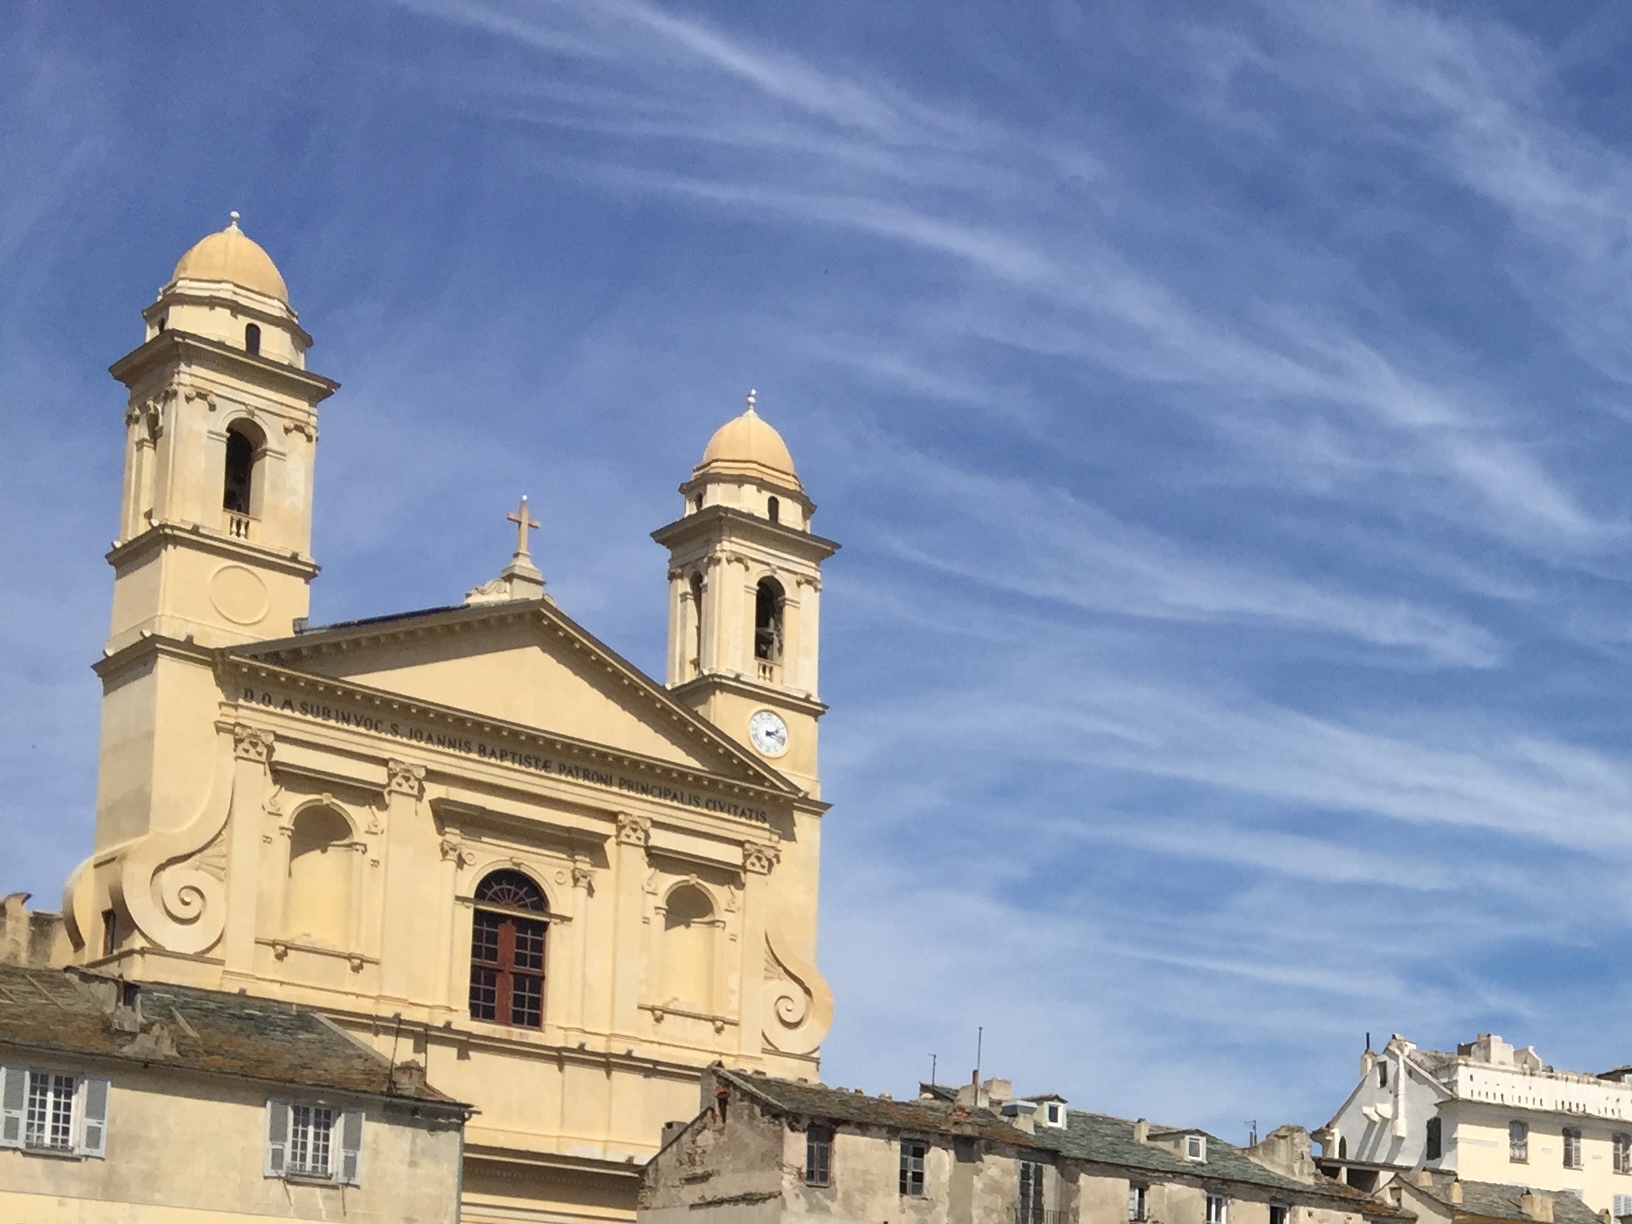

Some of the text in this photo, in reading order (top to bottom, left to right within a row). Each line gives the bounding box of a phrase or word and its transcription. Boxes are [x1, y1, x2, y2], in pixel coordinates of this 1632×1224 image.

[558, 763, 615, 788] PATRONI
[619, 777, 701, 807] PRINCIPALIS
[705, 798, 768, 822] CIVITATIS
